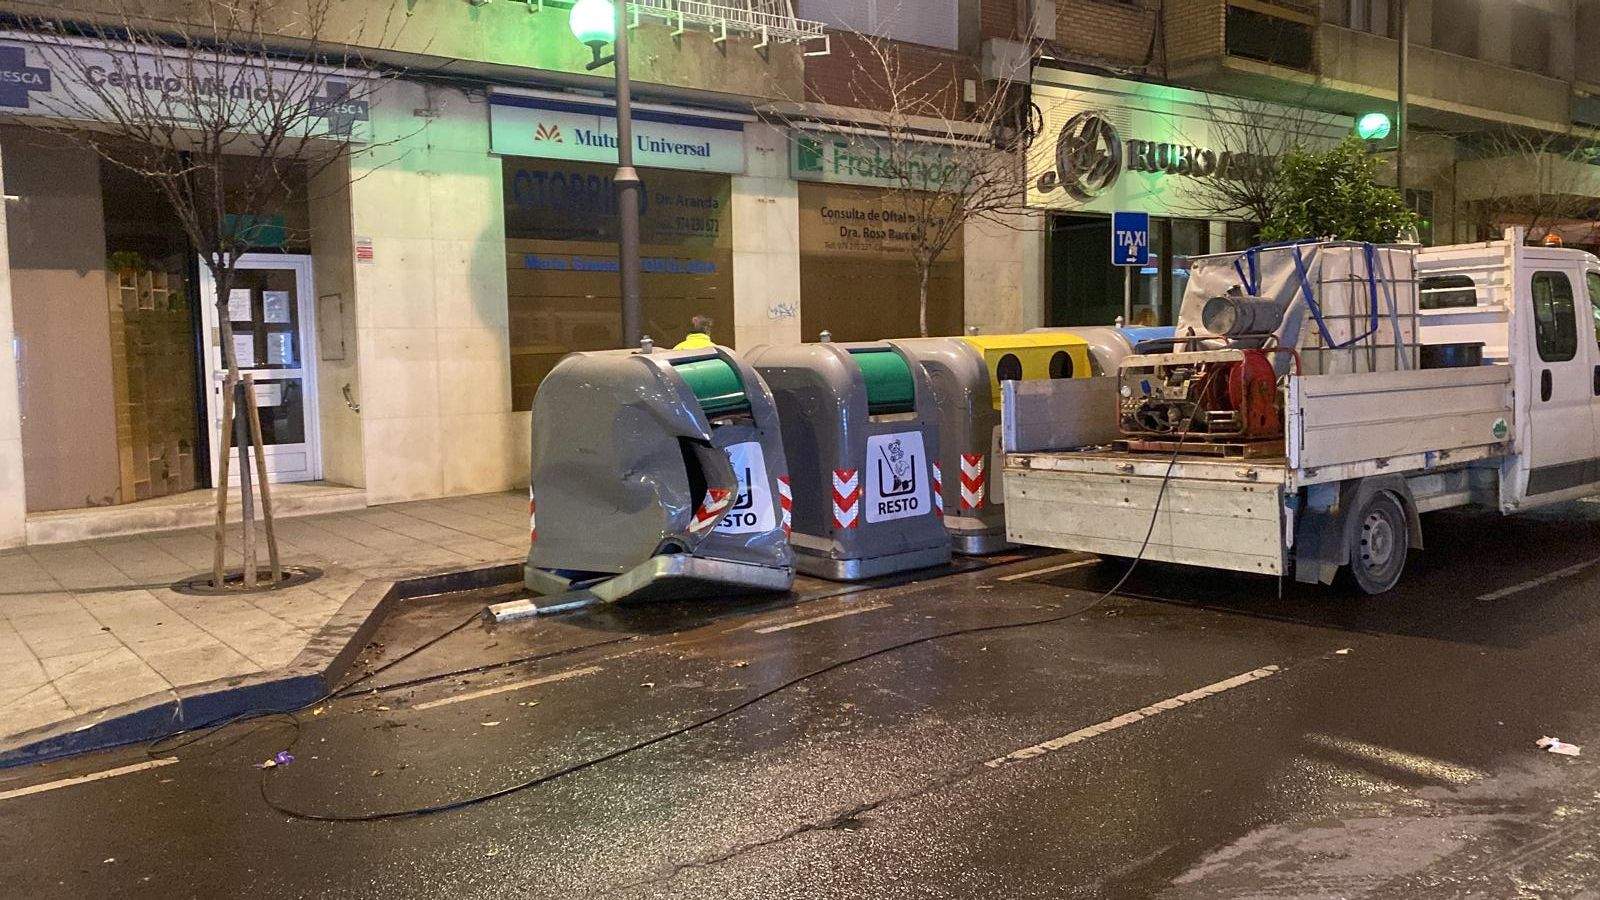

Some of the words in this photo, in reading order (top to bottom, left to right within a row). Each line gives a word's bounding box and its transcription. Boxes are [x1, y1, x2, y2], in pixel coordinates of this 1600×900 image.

[0, 71, 43, 84] ESCA
[87, 65, 181, 93] Centro
[574, 128, 618, 148] Mutu
[637, 134, 711, 158] Universal
[1127, 138, 1217, 177] RUBIO
[675, 194, 720, 209] Aranda
[820, 206, 866, 221] Consulta
[867, 209, 880, 221] de
[840, 226, 860, 238] Dra.
[863, 227, 886, 240] Rosa
[1116, 230, 1147, 248] TAXI
[878, 496, 919, 515] RESTO
[715, 512, 757, 528] STO
